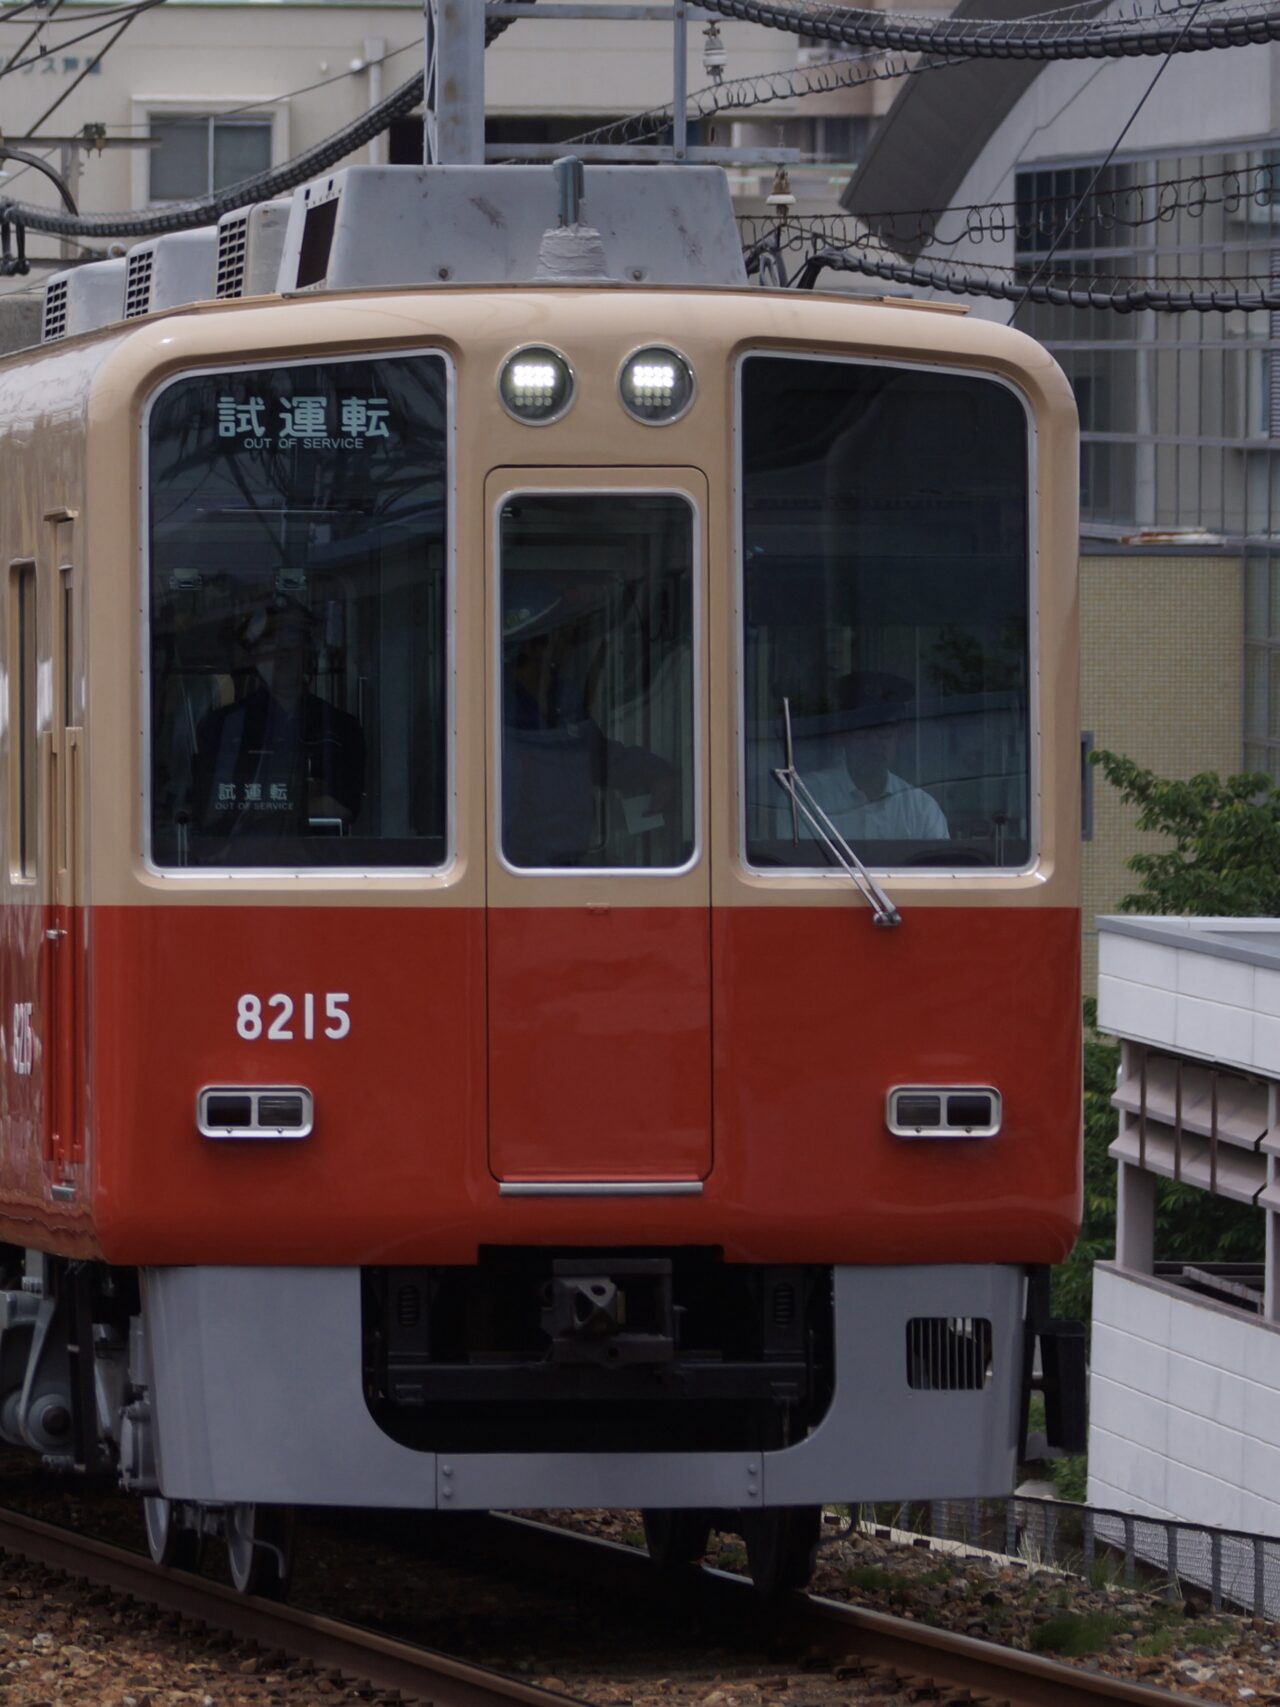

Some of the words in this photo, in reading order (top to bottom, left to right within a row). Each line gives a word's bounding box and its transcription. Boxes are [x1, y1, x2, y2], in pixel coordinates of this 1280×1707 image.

[217, 396, 391, 438] 試運転
[244, 438, 272, 449] OUT
[278, 438, 297, 449] OF
[303, 438, 364, 449] SERVICE
[218, 783, 288, 801] 試運転
[215, 802, 234, 810] OUT
[238, 802, 250, 810] OF
[254, 802, 294, 810] SERVICE
[236, 992, 351, 1040] 8215
